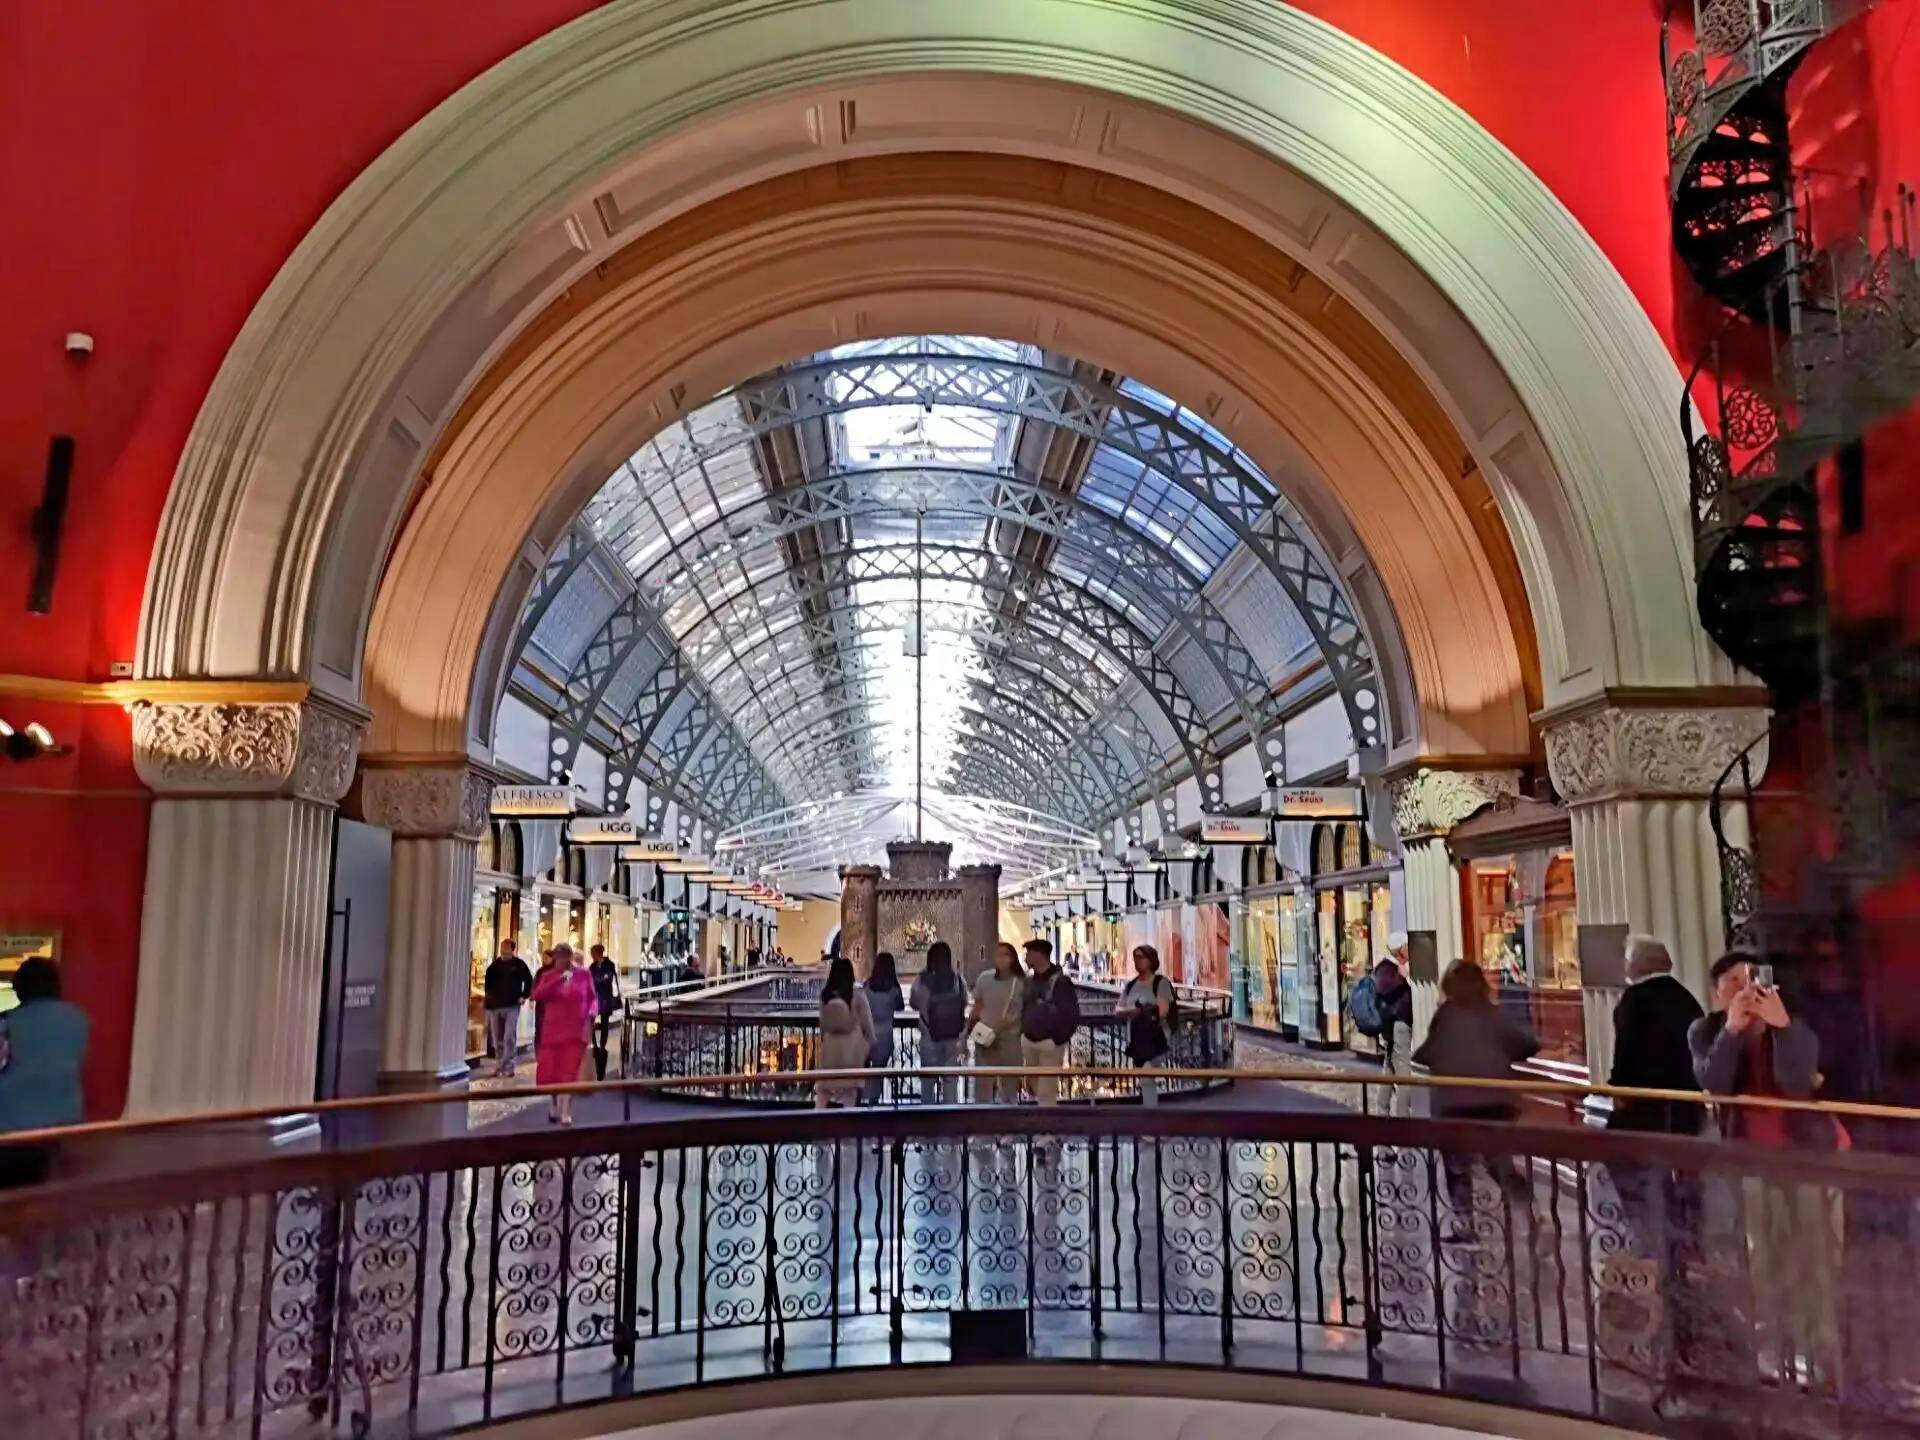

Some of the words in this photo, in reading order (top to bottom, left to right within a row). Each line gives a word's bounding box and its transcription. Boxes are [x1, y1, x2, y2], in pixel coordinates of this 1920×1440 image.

[494, 790, 564, 801] ALFRESCO
[600, 822, 632, 833] UGG
[647, 843, 674, 853] UGG
